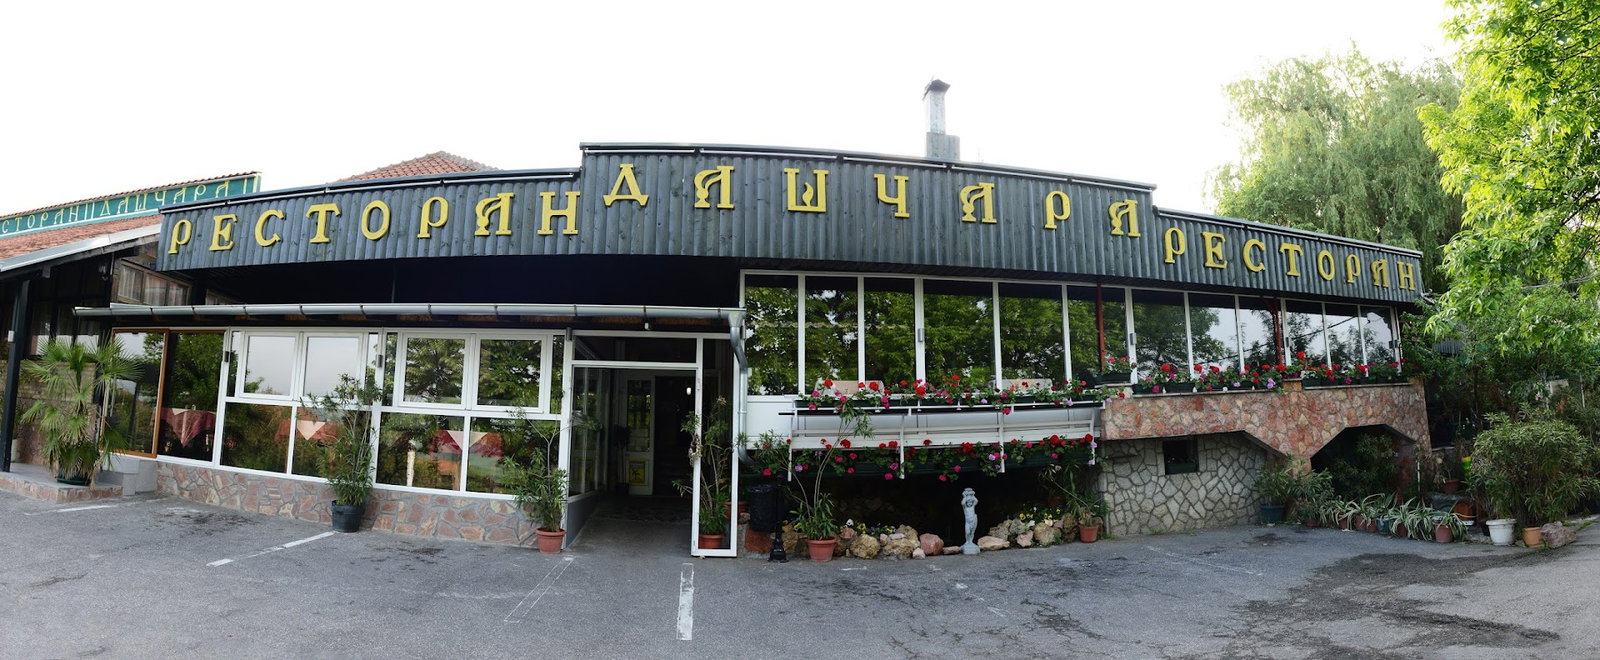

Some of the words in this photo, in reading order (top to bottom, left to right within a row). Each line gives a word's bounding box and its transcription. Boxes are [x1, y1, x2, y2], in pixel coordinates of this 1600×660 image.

[168, 190, 581, 254] РЕСТОРАН
[602, 162, 1142, 238] ДАШЧАРА
[1164, 227, 1416, 292] РЕСТОРАН
